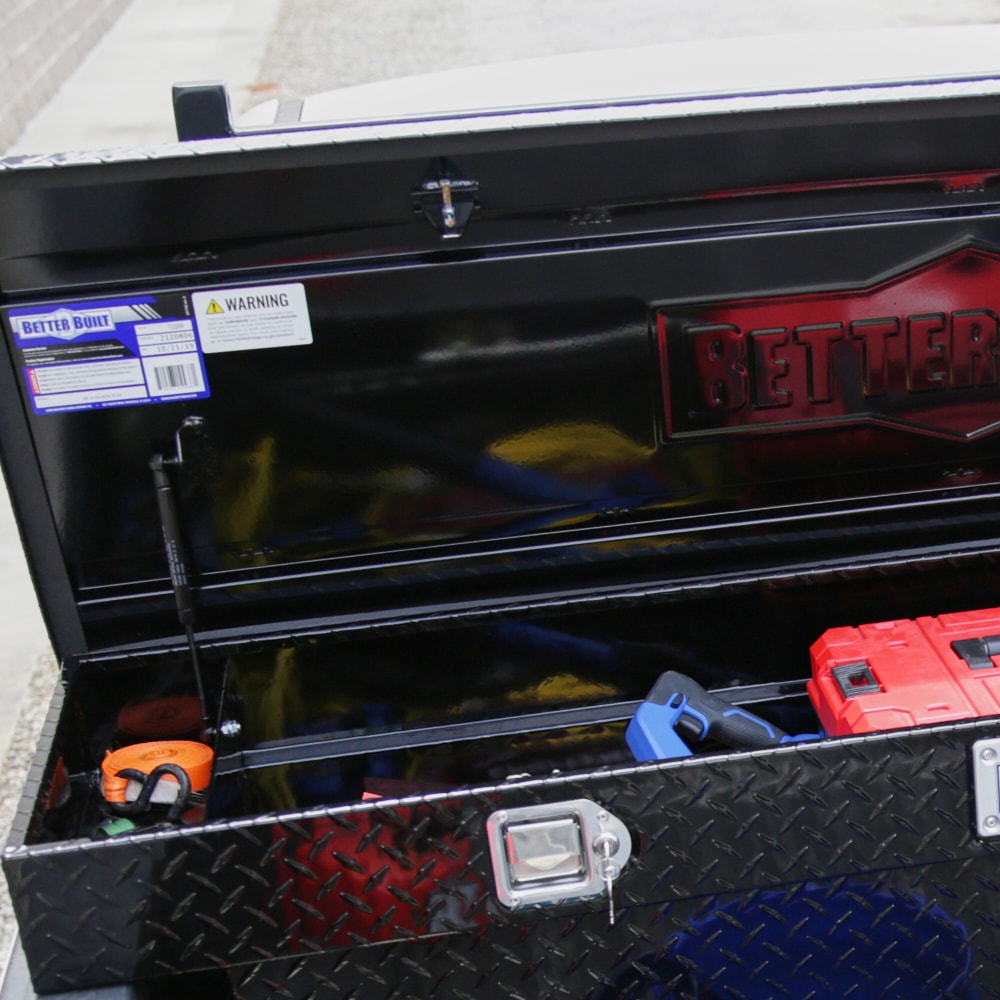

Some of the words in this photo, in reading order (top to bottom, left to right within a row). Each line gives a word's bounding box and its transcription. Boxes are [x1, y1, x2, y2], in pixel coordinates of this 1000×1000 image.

[224, 293, 289, 312] WARNING
[22, 319, 70, 335] BETTER
[73, 315, 109, 330] BUILT
[685, 309, 1000, 411] BETTER
